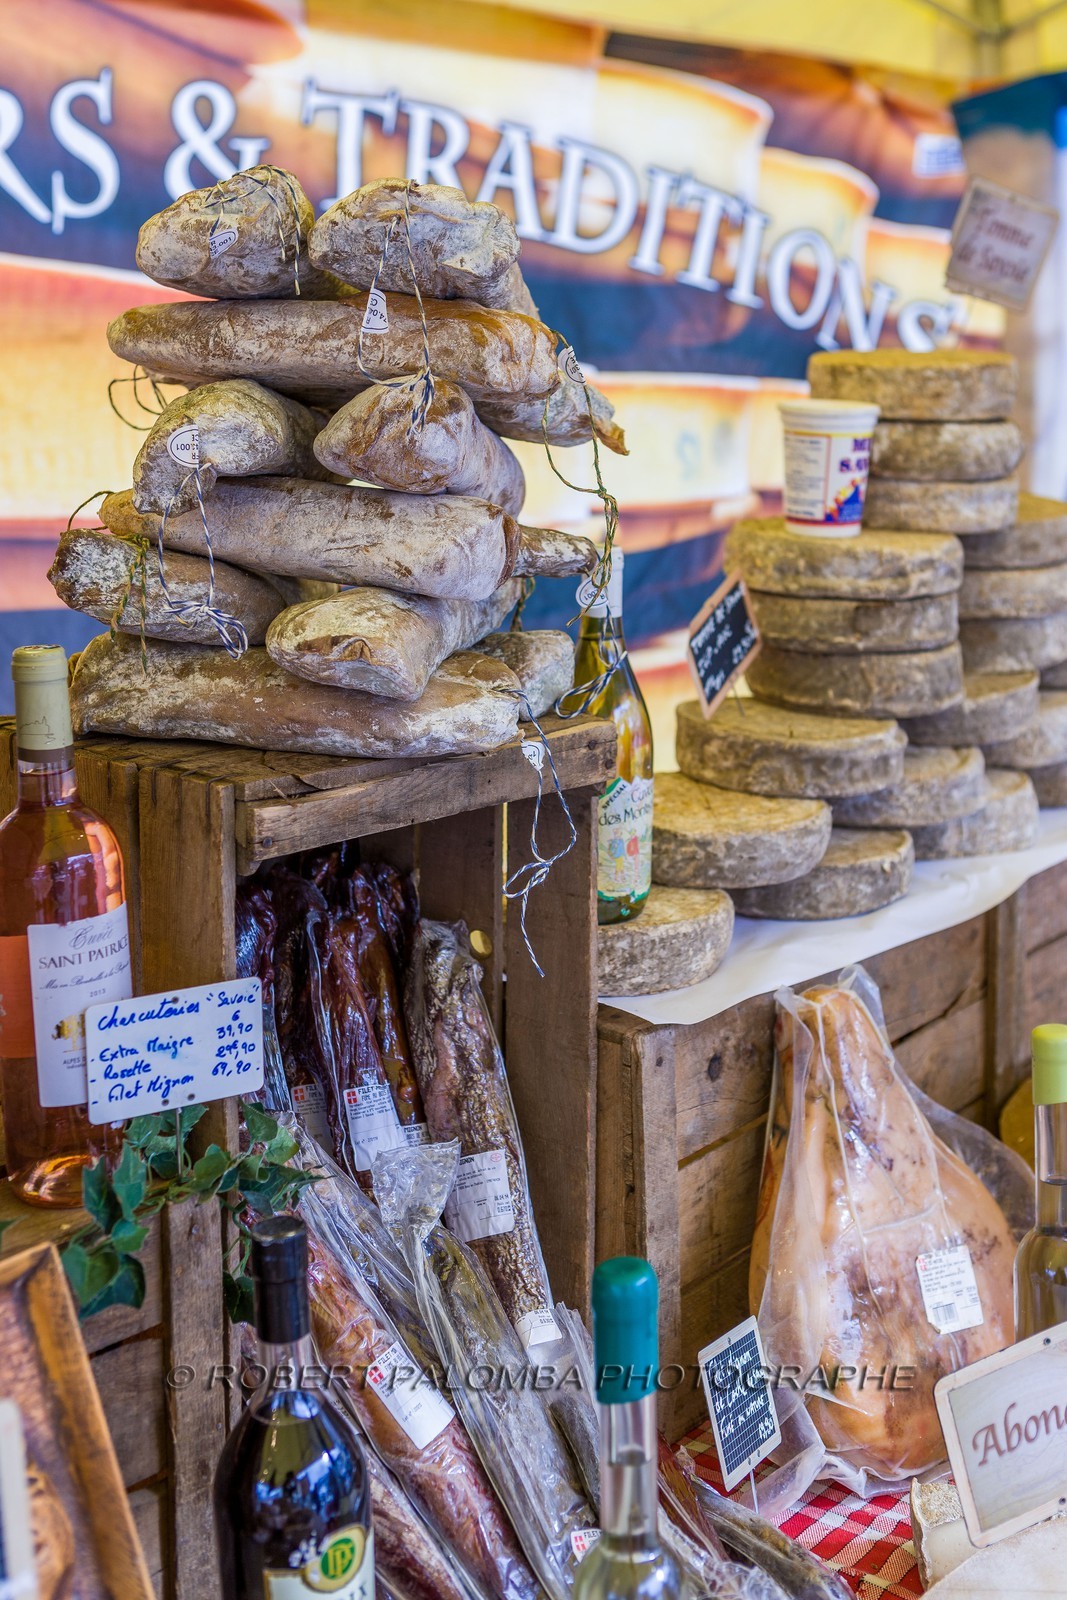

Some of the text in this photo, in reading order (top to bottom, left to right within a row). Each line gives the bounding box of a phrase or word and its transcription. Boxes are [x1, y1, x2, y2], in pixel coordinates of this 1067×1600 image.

[163, 80, 271, 202] &
[303, 78, 962, 352] TRADITIONS
[598, 812, 622, 827] des
[39, 953, 84, 970] SAINT
[89, 988, 107, 998] 2013
[99, 1023, 253, 1063] Extra Maigre 39,90
[103, 1060, 152, 1081] Rosette
[108, 1080, 143, 1103] Filet
[147, 1075, 195, 1099] Mignon
[357, 1085, 375, 1095] FILET
[972, 1402, 1067, 1467] Abon
